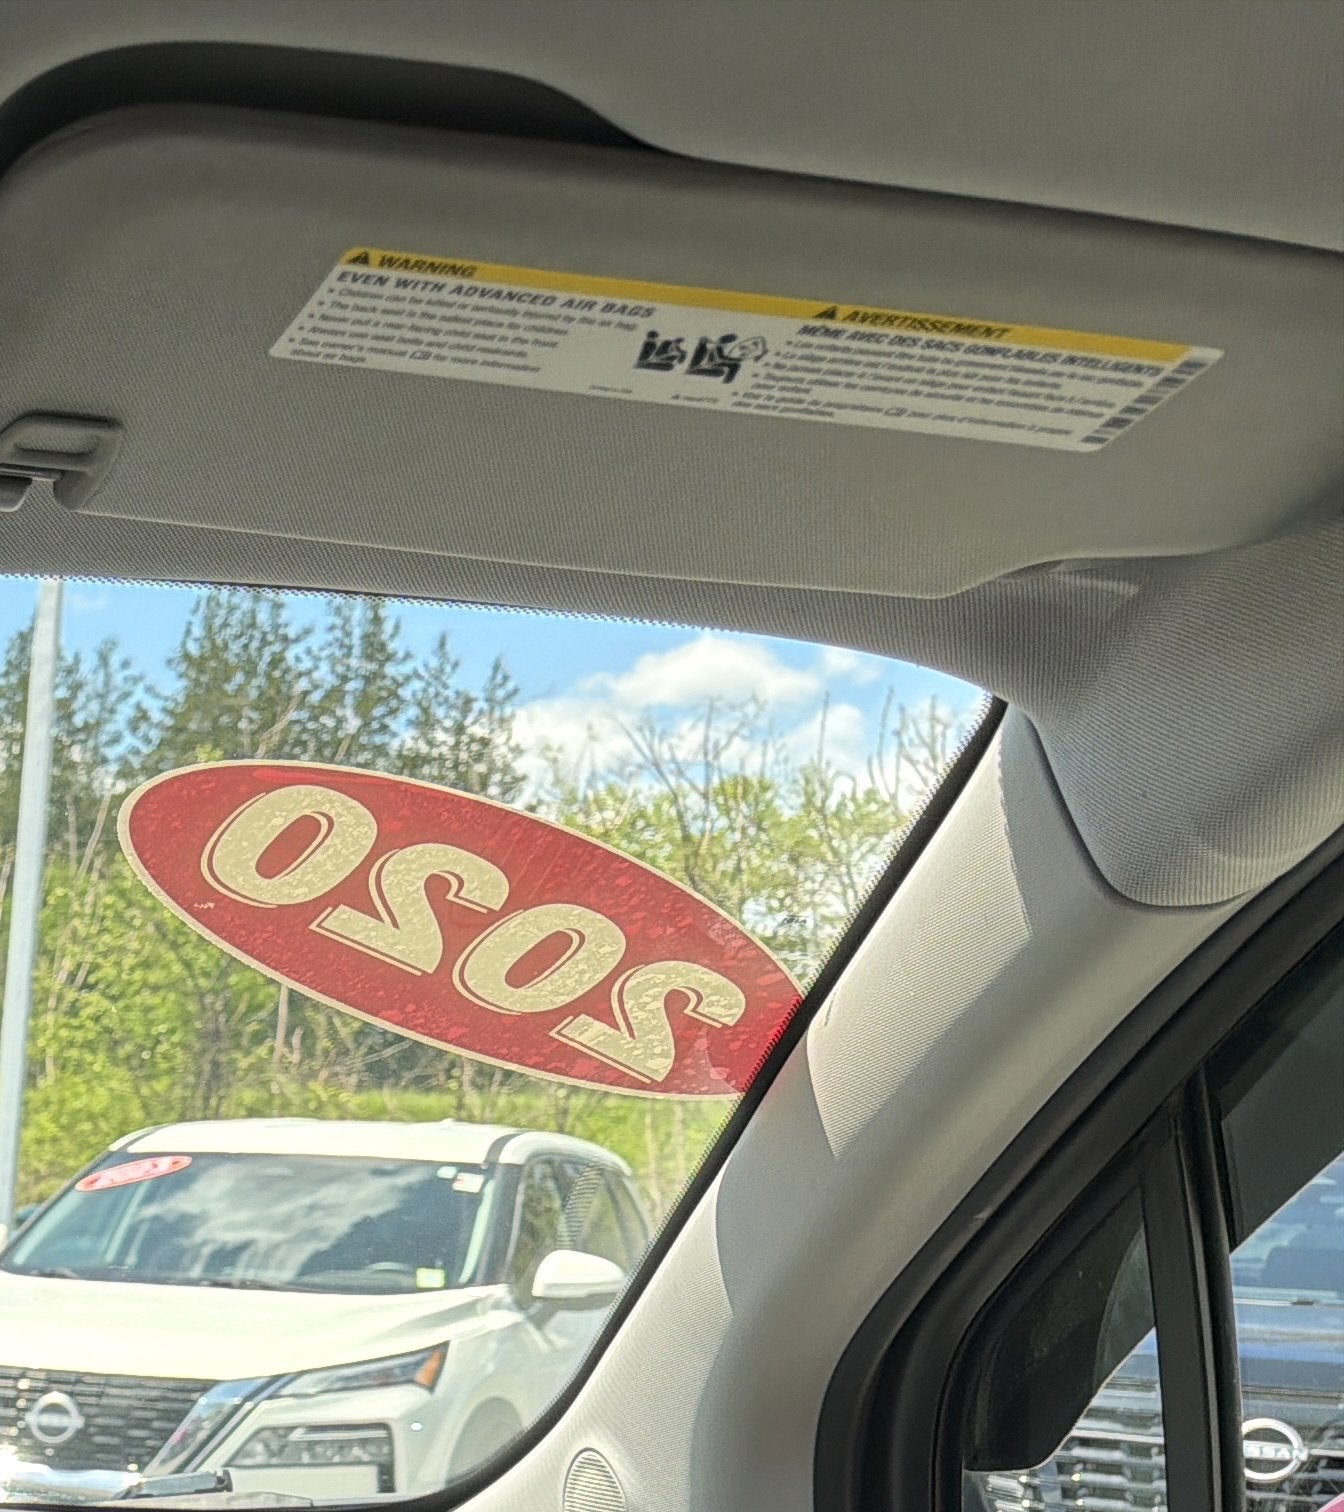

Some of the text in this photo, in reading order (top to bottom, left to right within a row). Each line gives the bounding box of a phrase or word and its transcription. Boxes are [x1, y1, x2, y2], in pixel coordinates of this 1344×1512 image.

[378, 254, 478, 278] WARNING
[336, 271, 657, 319] EVEN WITH ADVANCED AIR BAGS
[842, 310, 1011, 340] AVERTISSEMENT
[846, 330, 891, 345] AVEC
[887, 334, 923, 348] DES
